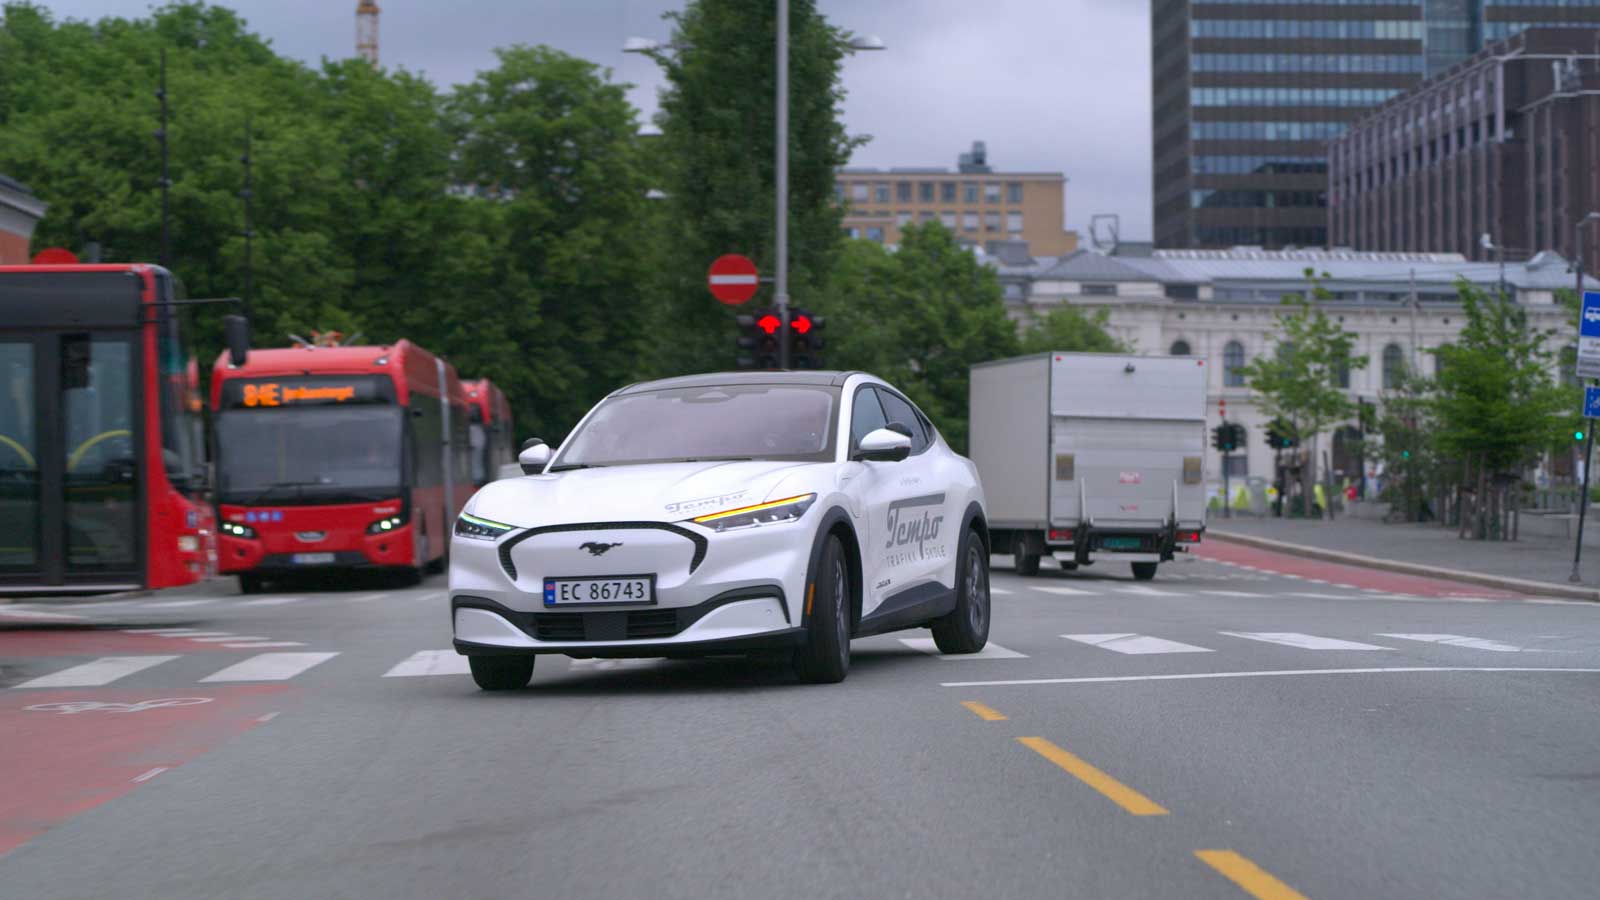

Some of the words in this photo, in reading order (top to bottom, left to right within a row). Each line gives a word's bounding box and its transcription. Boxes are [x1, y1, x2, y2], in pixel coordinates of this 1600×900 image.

[665, 489, 749, 513] Tempo
[886, 493, 945, 560] Tempo
[561, 583, 581, 600] EC
[590, 582, 644, 600] 86743
